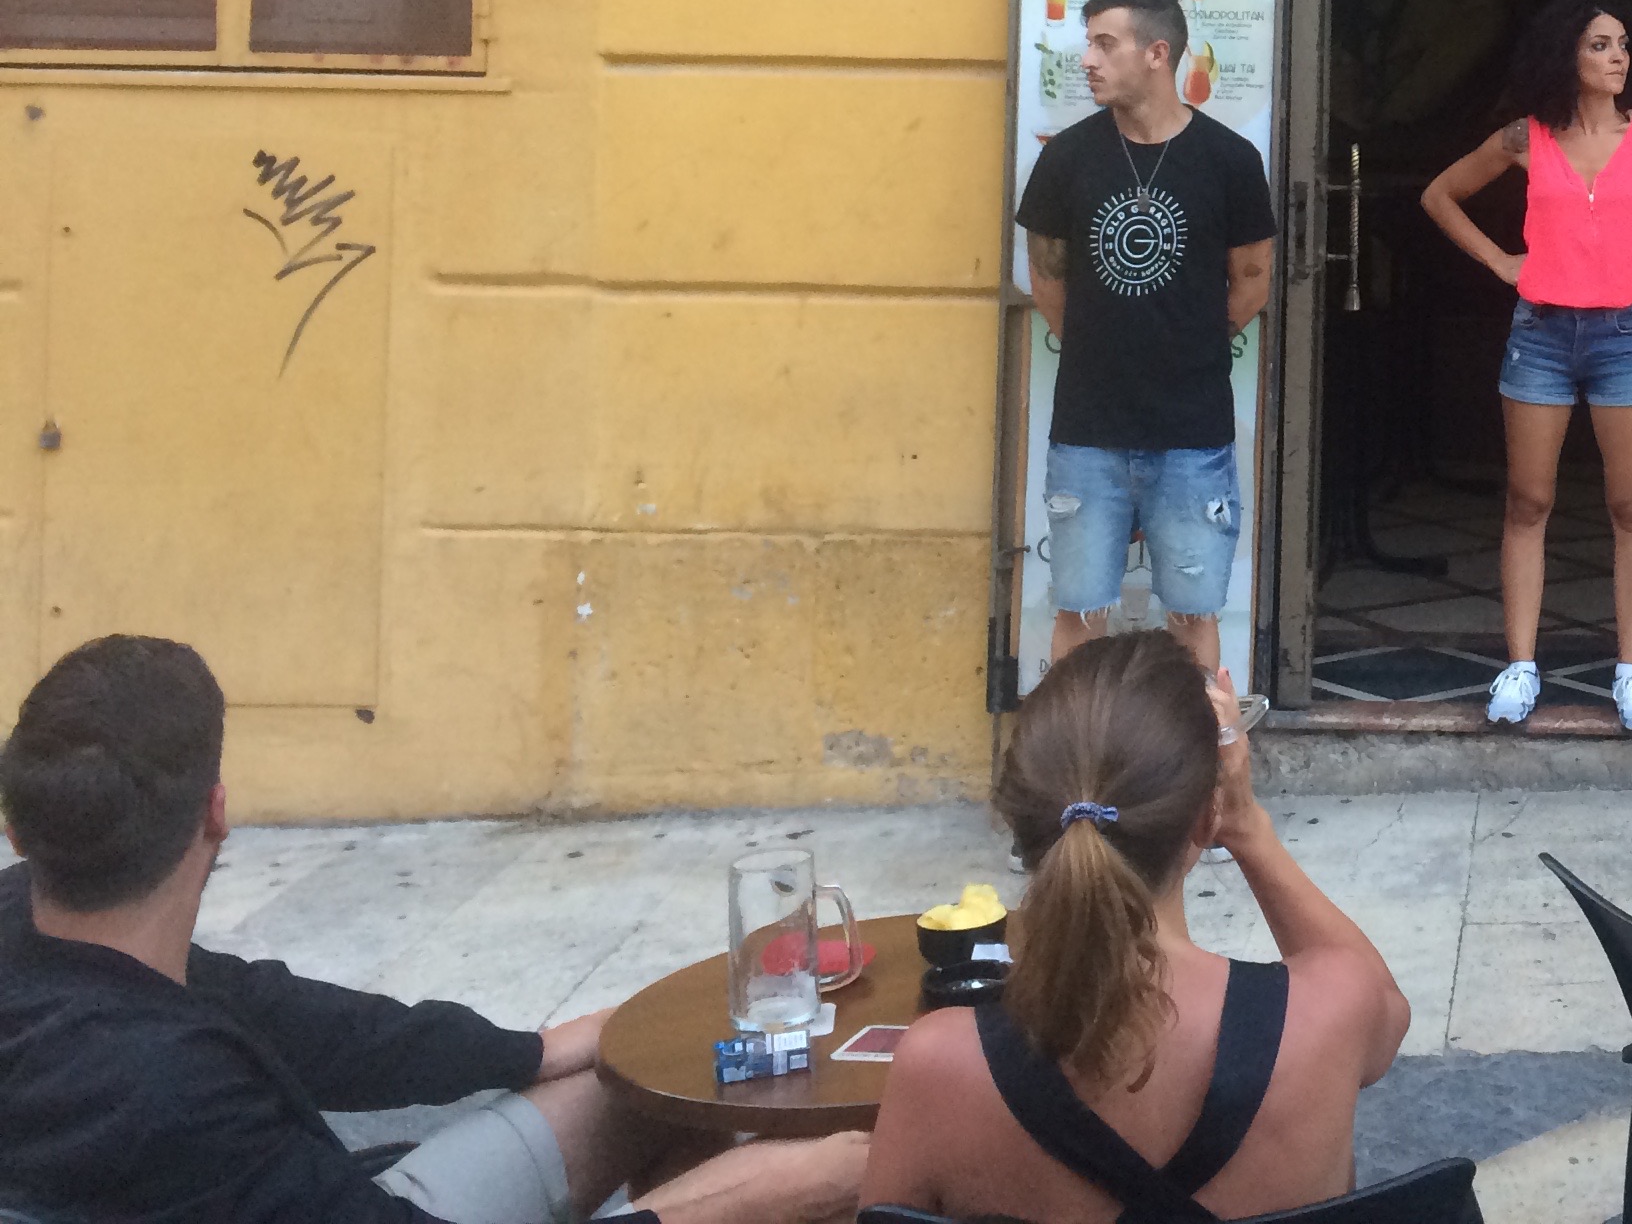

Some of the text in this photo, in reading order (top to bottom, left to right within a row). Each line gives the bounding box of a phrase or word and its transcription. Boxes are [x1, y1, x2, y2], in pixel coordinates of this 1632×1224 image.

[1106, 205, 1172, 235] OLD GRAGE
[1122, 225, 1158, 258] G
